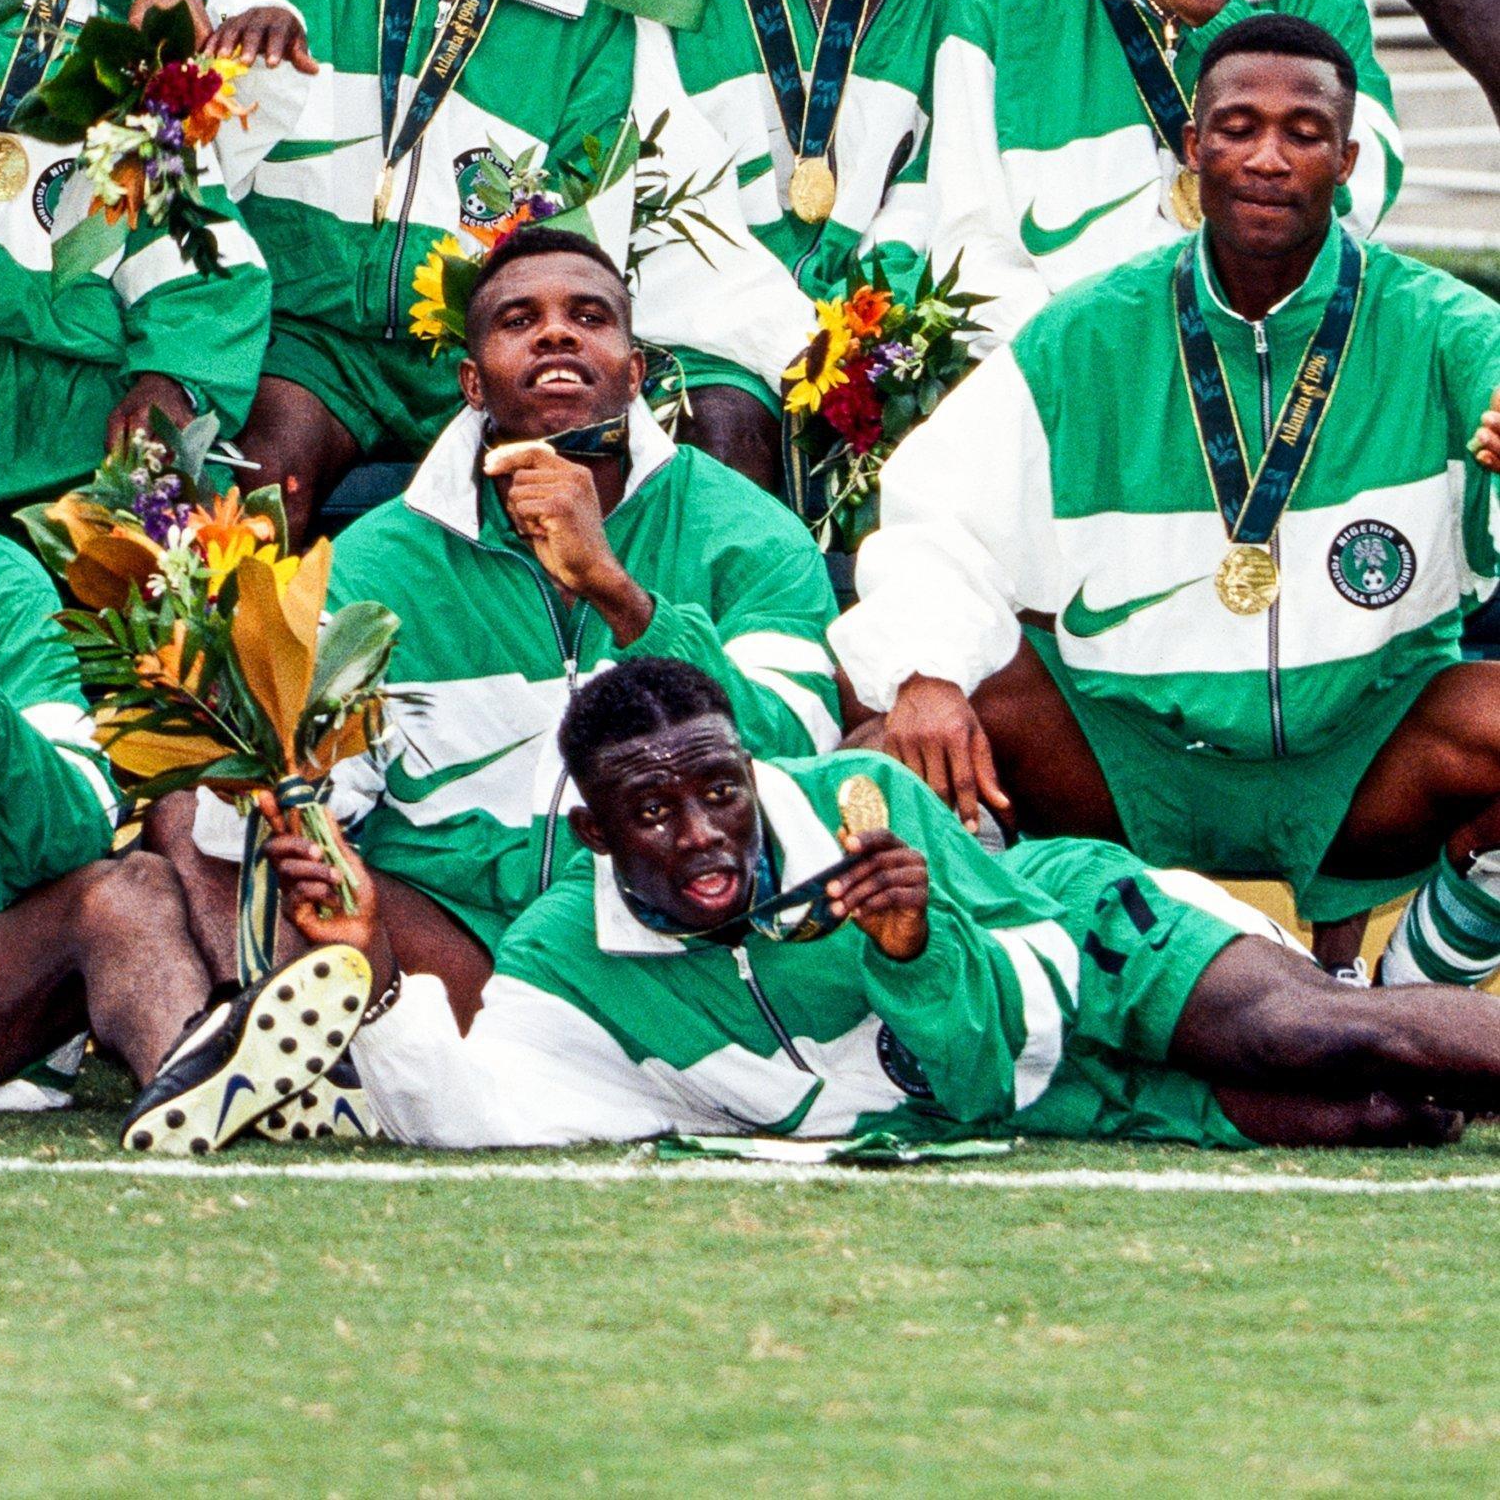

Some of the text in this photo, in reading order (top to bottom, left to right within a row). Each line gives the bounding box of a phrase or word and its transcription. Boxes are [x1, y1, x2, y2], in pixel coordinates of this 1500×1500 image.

[433, 32, 465, 78] Atlanta
[1279, 354, 1327, 447] Atlanta 1996
[1337, 523, 1395, 547] NIGERIA
[1331, 544, 1412, 605] FOOTBALL ASSOCIATION
